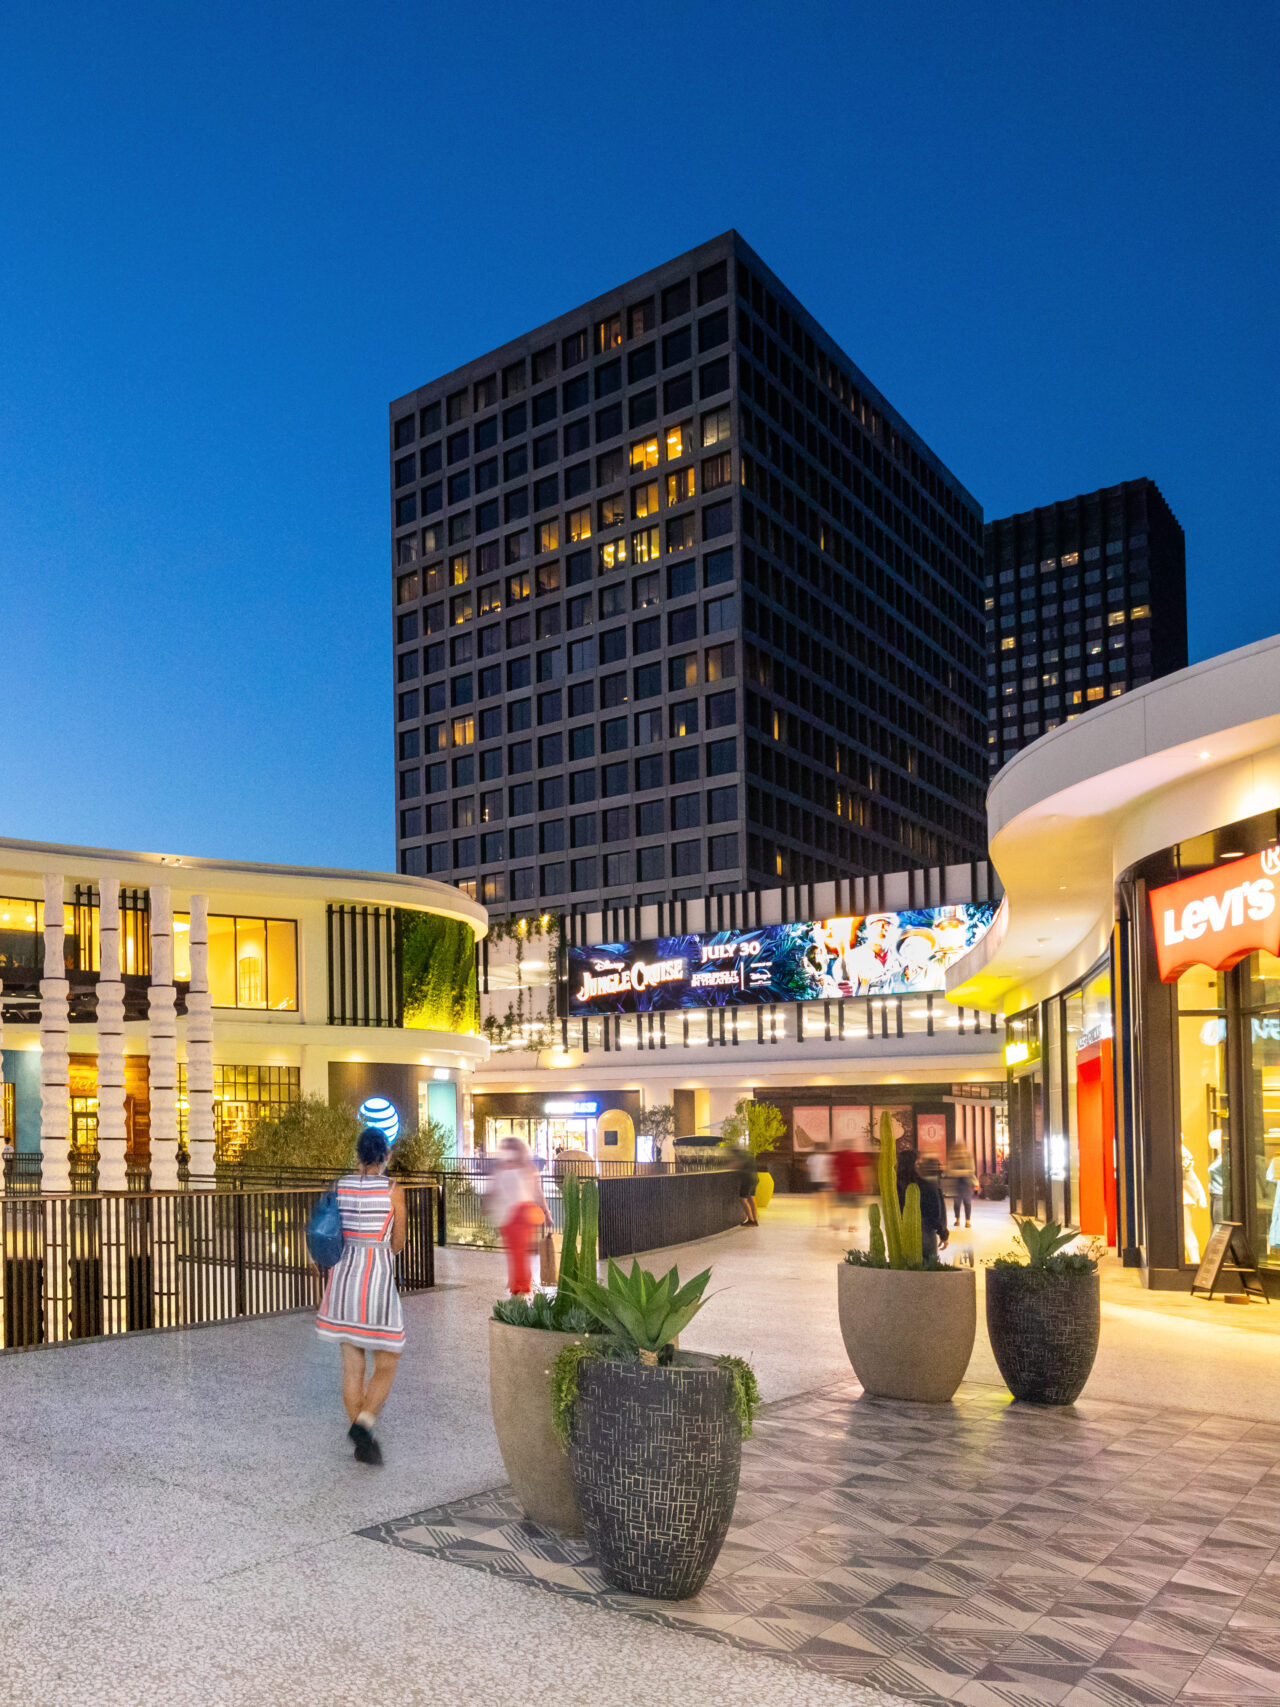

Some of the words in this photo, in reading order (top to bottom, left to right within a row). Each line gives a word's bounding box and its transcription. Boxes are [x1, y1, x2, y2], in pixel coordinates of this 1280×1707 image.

[701, 944, 737, 963] JULY
[738, 941, 761, 956] 30
[594, 959, 625, 972] Disney
[576, 971, 632, 1001] JUNGLE
[631, 958, 684, 991] CRUISE
